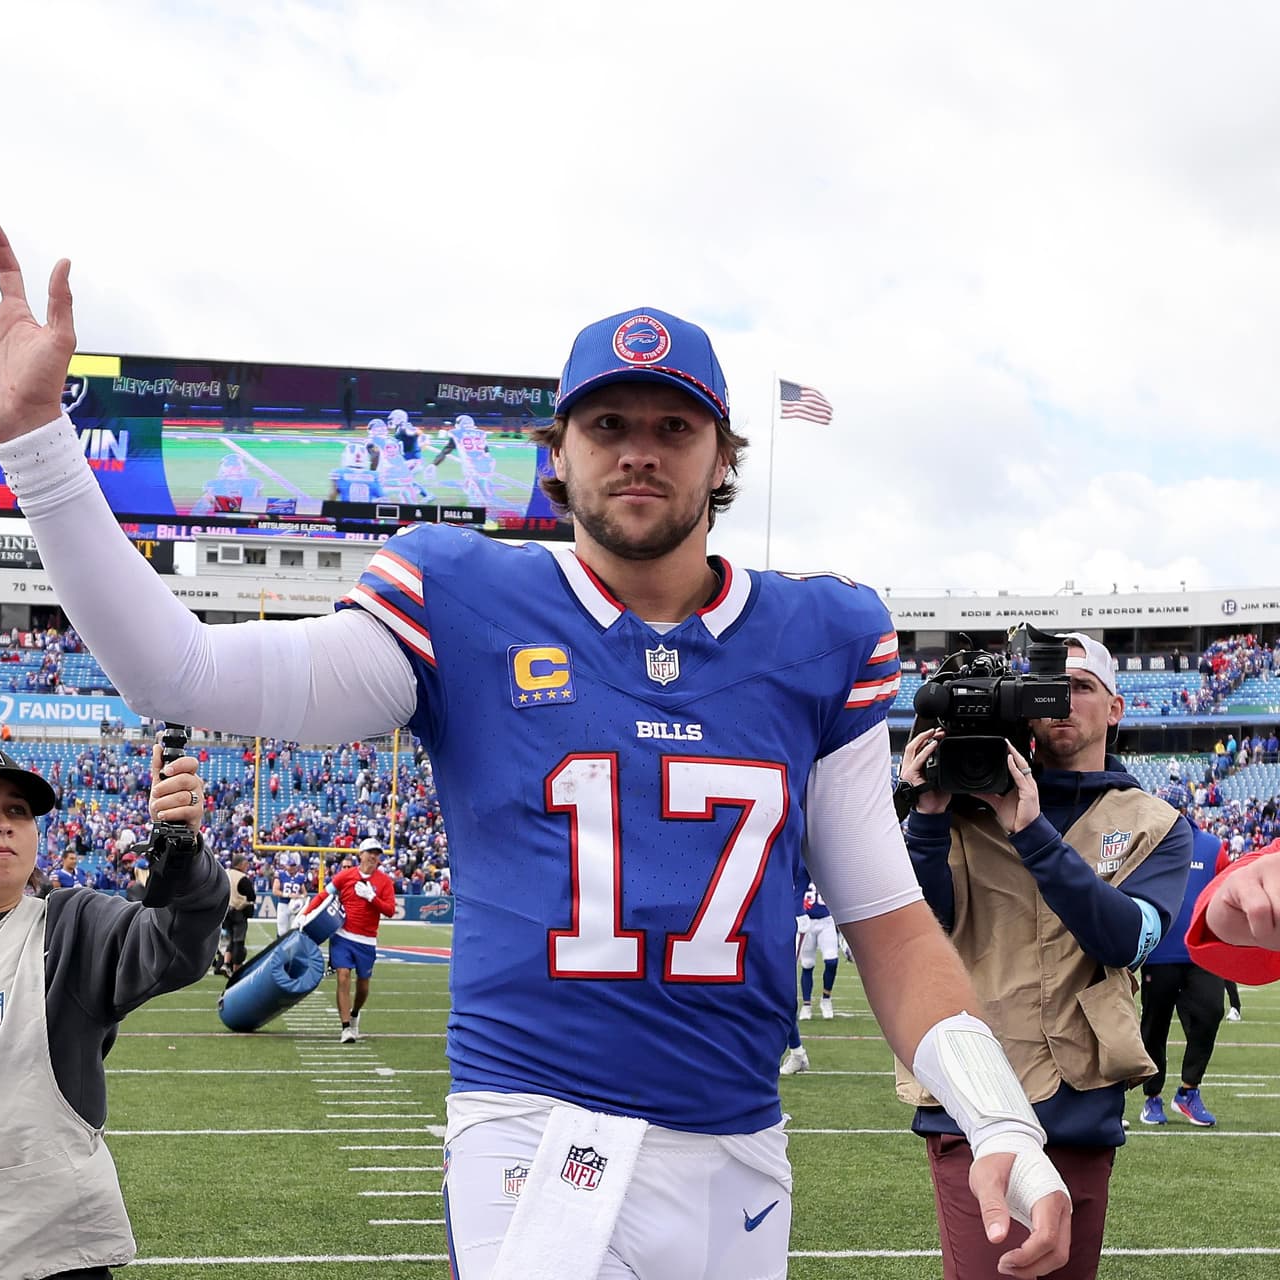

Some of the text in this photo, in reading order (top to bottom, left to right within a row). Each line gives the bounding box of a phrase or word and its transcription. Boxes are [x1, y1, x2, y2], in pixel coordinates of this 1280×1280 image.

[258, 521, 337, 532] MITSUBISHI ELECTRIC
[12, 582, 27, 592] 70
[898, 610, 936, 618] JAMES
[960, 608, 1060, 618] EDDIE ABRAMOSKI
[1098, 606, 1144, 616] GEORGE
[1148, 605, 1190, 614] SAIMES
[1223, 602, 1236, 613] 12
[1240, 602, 1261, 611] JIM
[513, 646, 570, 691] C
[652, 661, 674, 678] NFL
[19, 702, 117, 722] FANDUEL
[635, 720, 704, 741] BILLS
[543, 750, 789, 985] 17
[282, 882, 301, 896] 69
[563, 1161, 597, 1189] NFL
